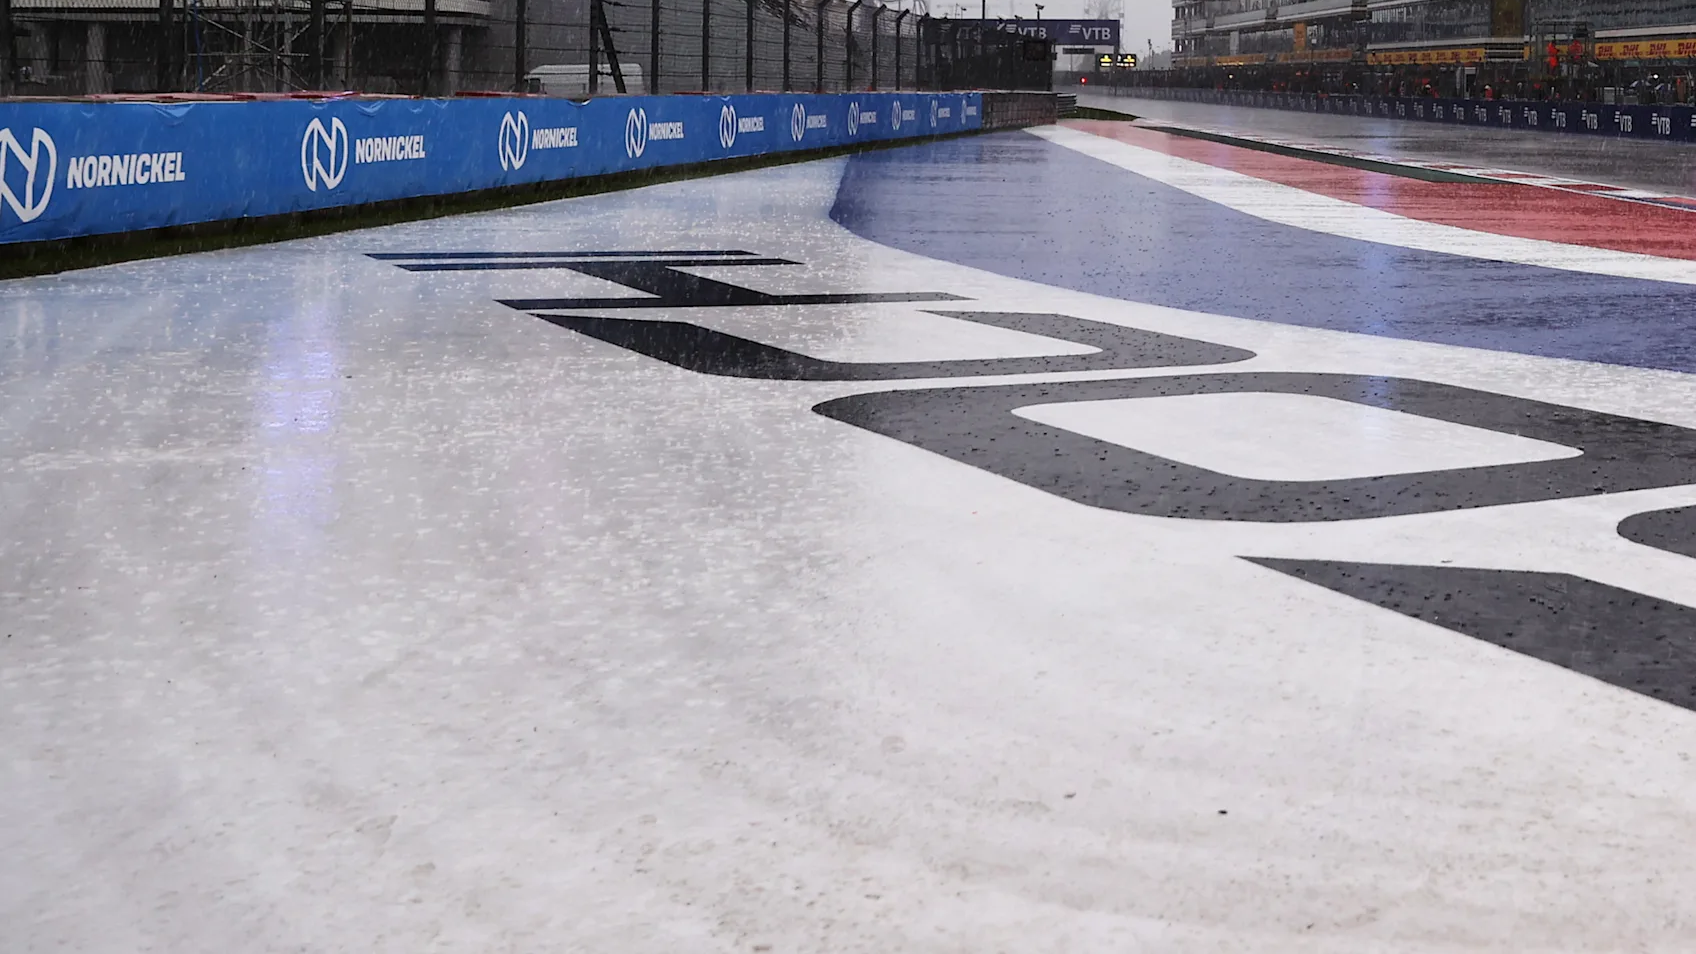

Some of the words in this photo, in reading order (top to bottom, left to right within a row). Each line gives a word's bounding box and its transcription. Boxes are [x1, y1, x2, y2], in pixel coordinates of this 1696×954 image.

[1082, 26, 1111, 40] VTB
[649, 122, 684, 141] NORNICKEL
[738, 116, 765, 134] NORNICKEL
[1619, 116, 1632, 132] VTB
[1657, 117, 1670, 135] VTB
[531, 127, 578, 150] NORNICKEL
[355, 135, 426, 164] NORNICKEL
[66, 152, 185, 189] NORNICKEL
